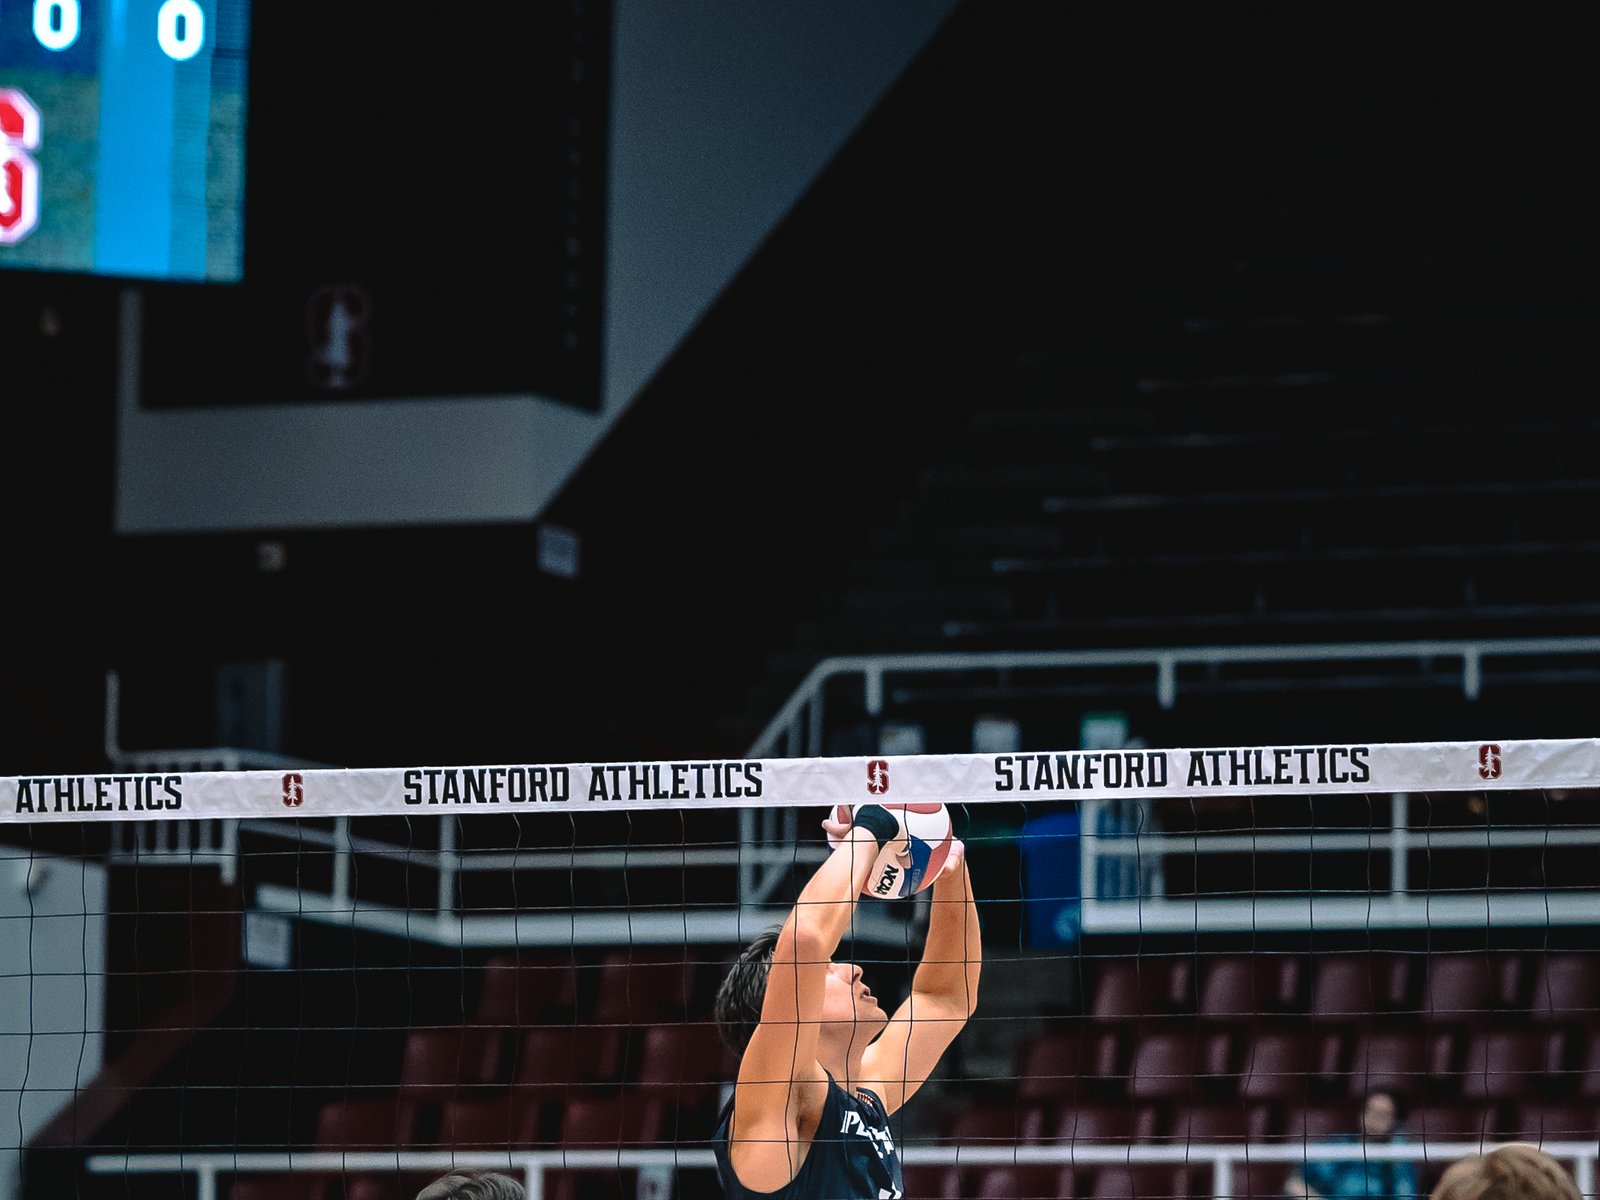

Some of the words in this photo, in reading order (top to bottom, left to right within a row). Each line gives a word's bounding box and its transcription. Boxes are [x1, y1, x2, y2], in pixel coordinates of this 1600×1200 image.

[33, 0, 81, 51] 0
[157, 0, 206, 61] 0
[403, 766, 570, 806] STANFORD
[588, 761, 763, 802] ATHLETICS
[995, 751, 1168, 792] STANFORD
[1187, 746, 1370, 787] ATHLETICS
[15, 775, 182, 814] ATHLETICS
[874, 864, 899, 895] NCAA
